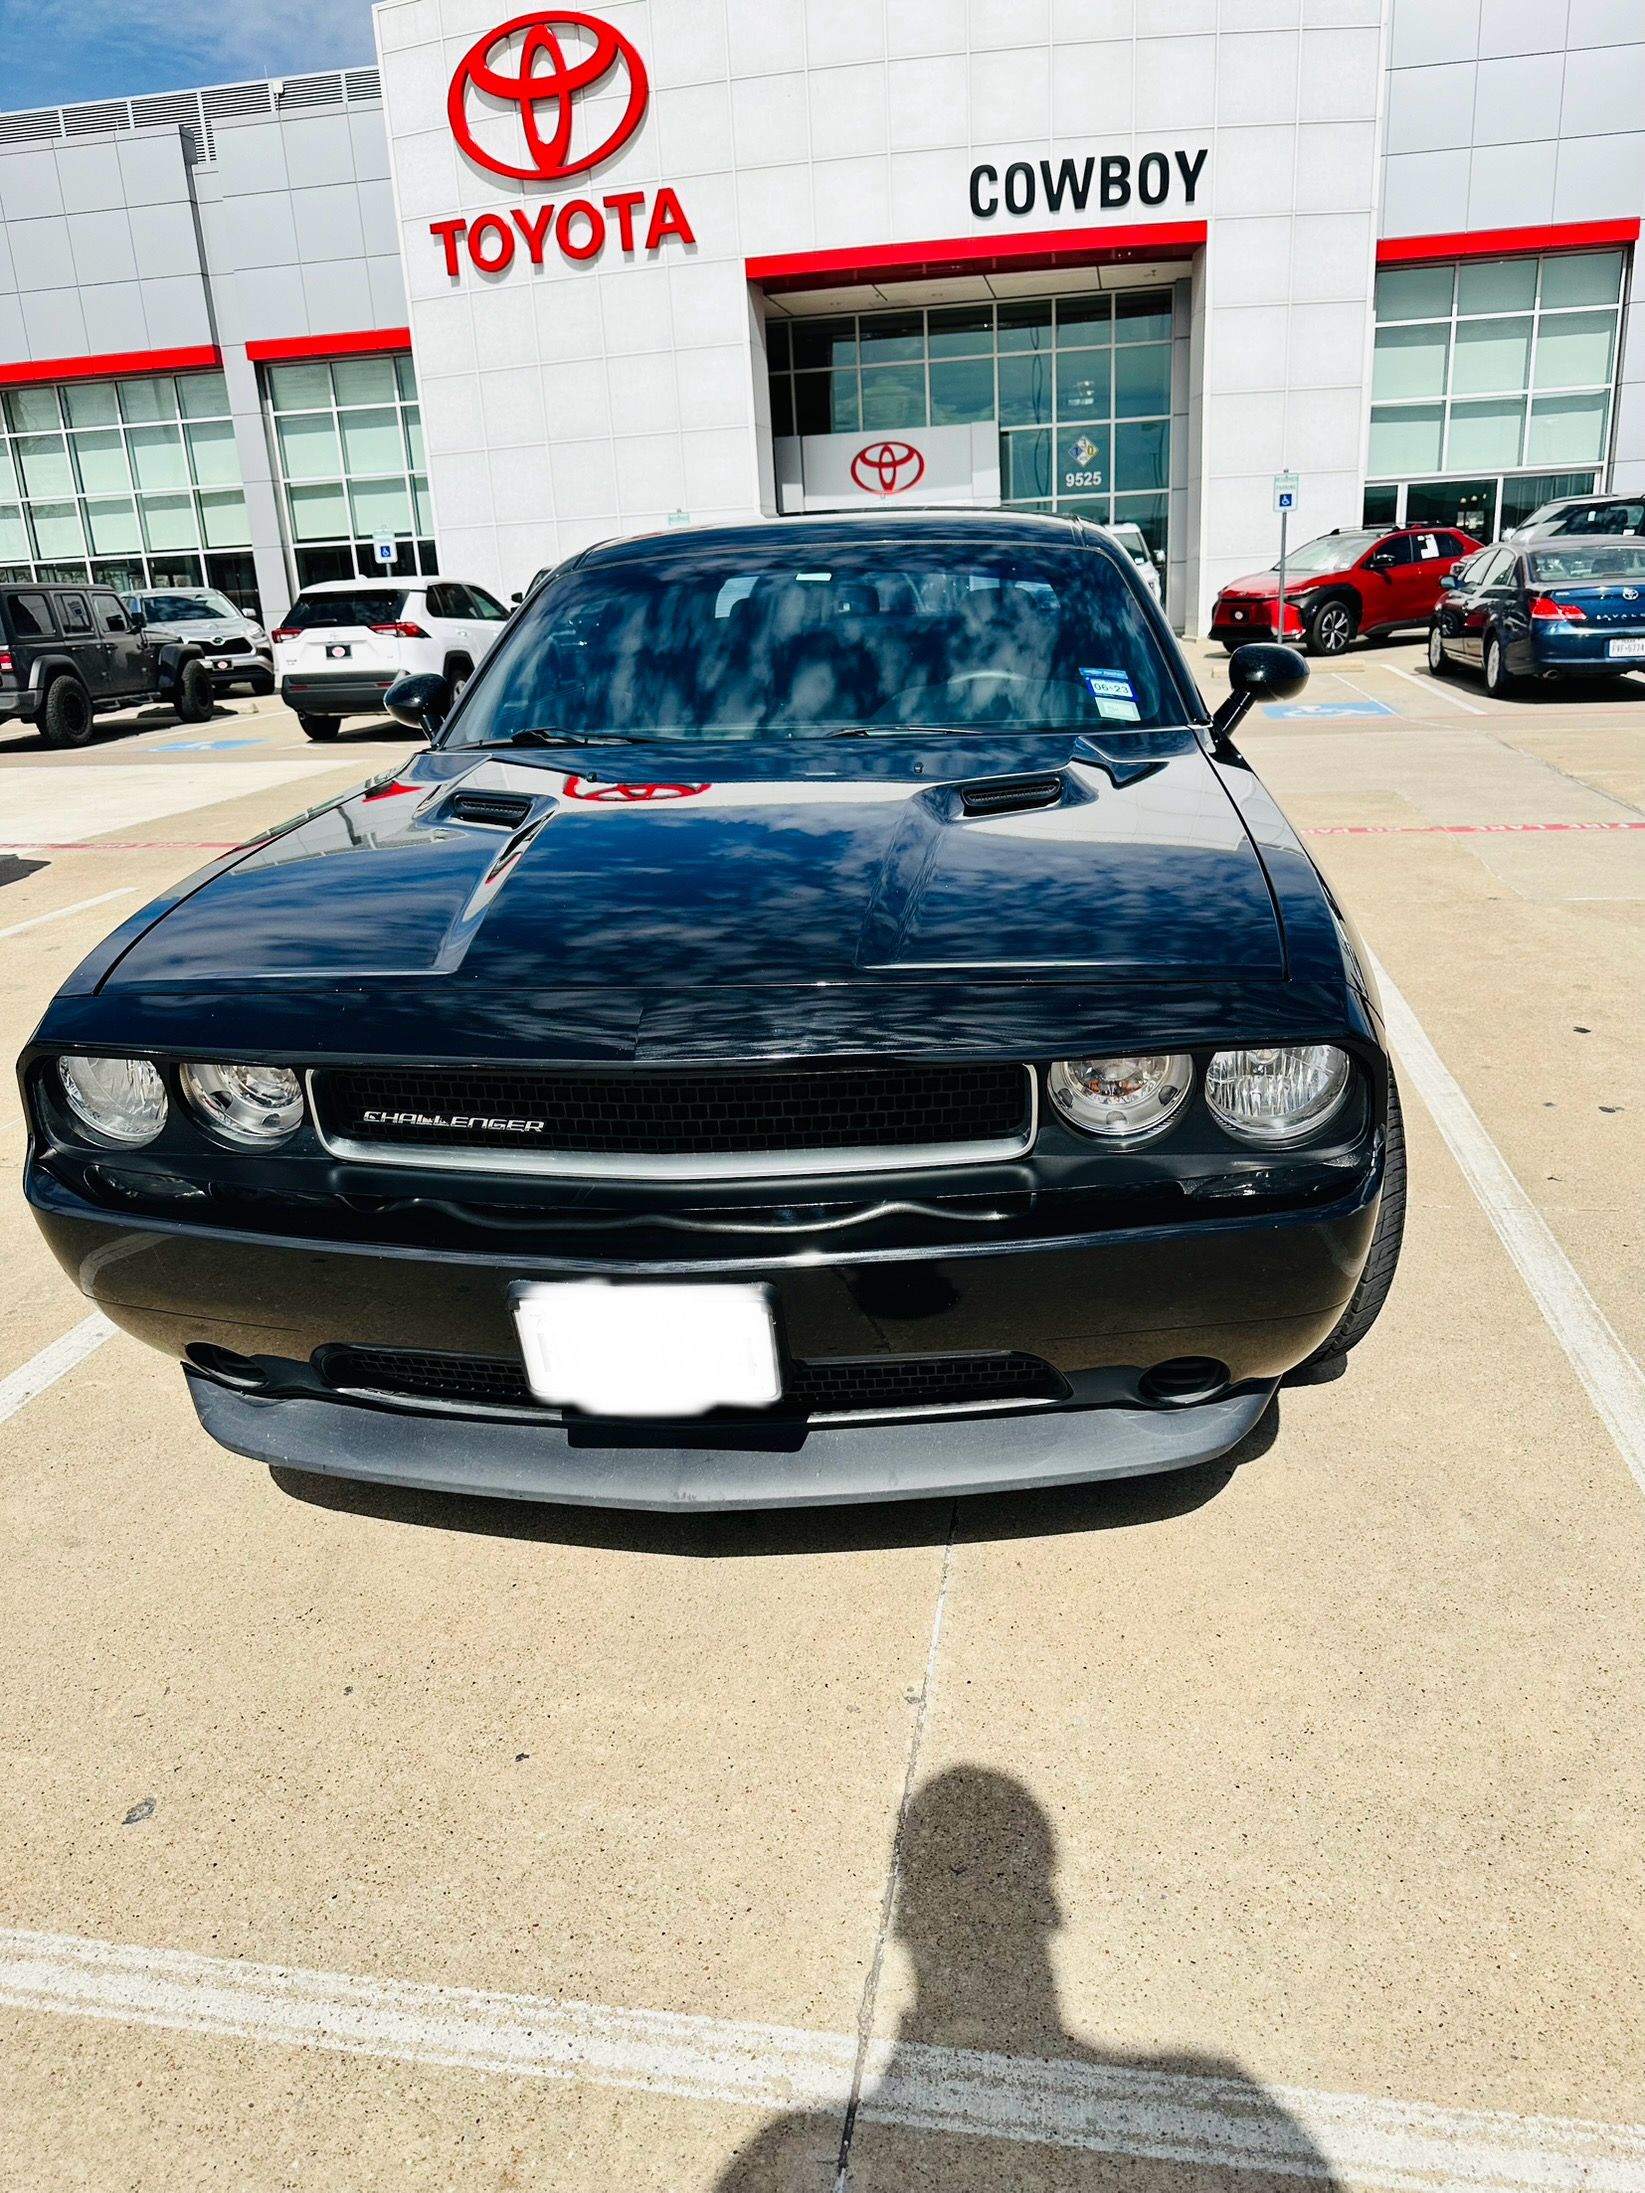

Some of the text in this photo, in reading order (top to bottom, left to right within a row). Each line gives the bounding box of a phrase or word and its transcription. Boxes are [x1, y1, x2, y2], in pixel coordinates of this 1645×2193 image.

[969, 149, 1208, 218] COWBOY
[429, 187, 696, 277] TOYOTA
[1065, 471, 1102, 488] 9525
[363, 1110, 545, 1132] CHALLENGER
